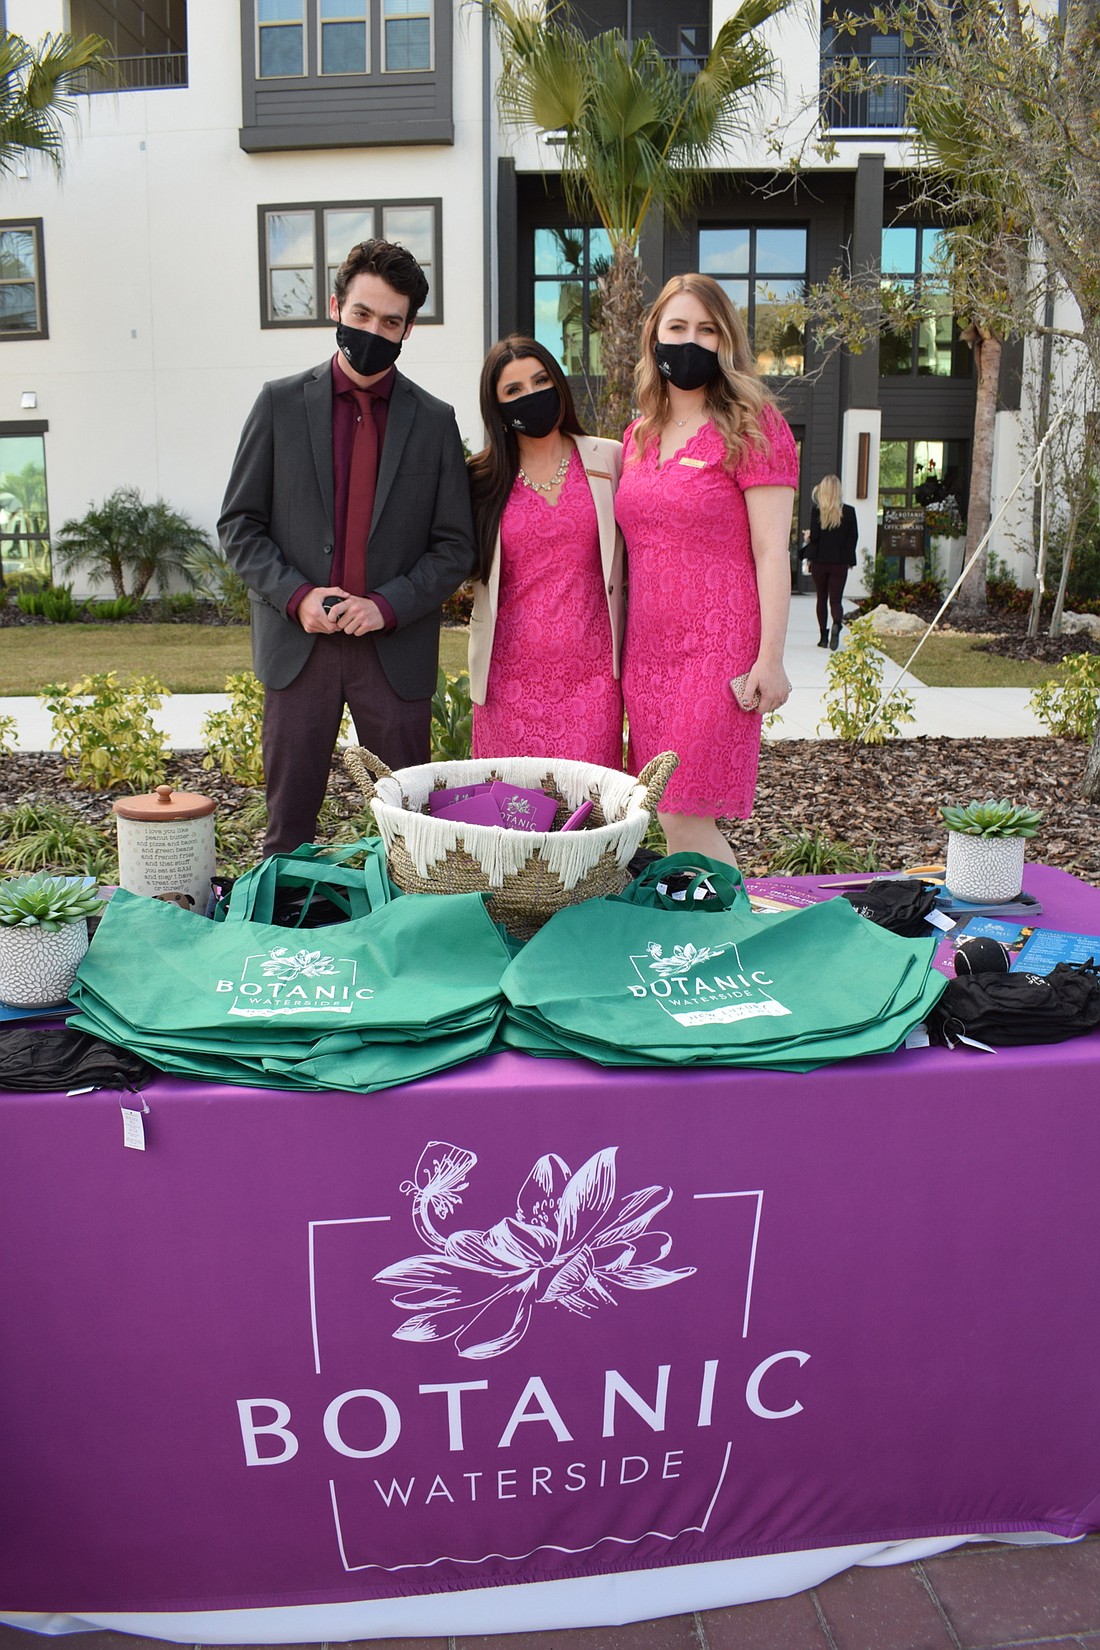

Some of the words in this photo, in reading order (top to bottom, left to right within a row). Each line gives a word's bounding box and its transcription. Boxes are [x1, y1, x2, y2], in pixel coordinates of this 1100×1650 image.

[500, 811, 537, 831] OTANIC
[216, 979, 375, 1000] BOTANIC
[627, 971, 774, 998] BOTANIC
[249, 997, 341, 1006] WATERSIDE
[668, 990, 753, 1006] WATERSIDE
[236, 1350, 812, 1467] BOTANIC
[374, 1450, 685, 1508] WATERSIDE
